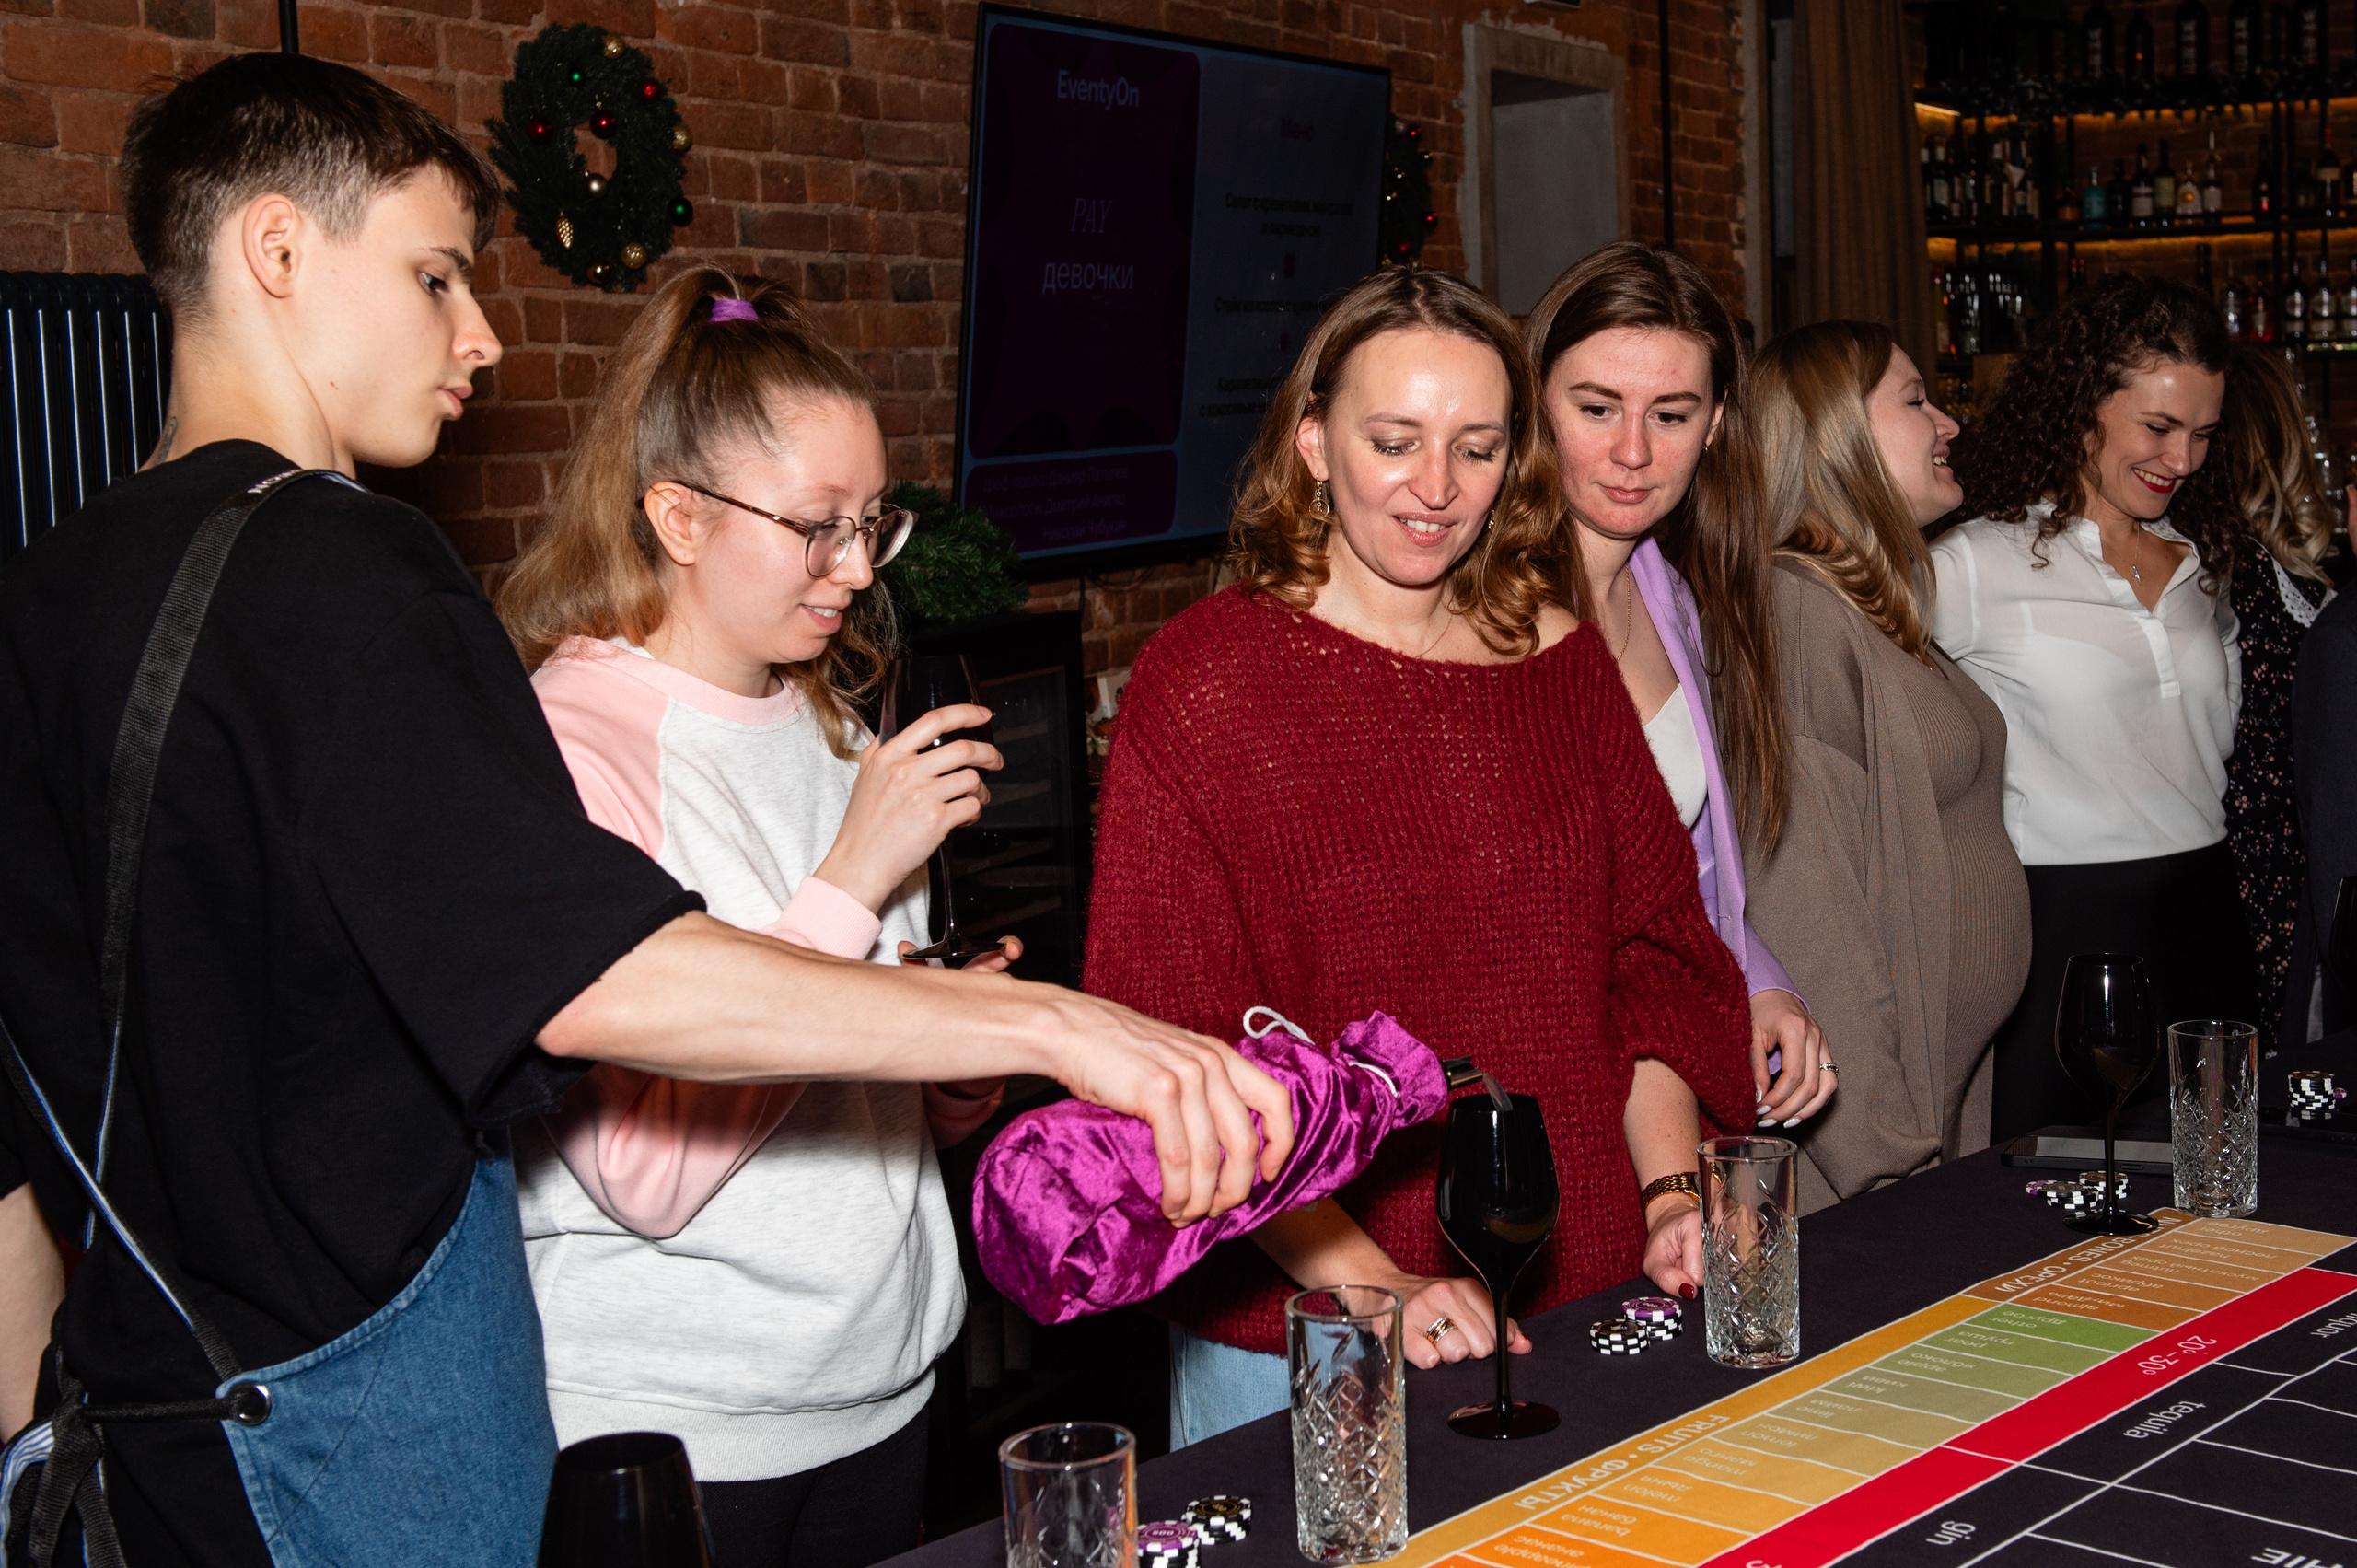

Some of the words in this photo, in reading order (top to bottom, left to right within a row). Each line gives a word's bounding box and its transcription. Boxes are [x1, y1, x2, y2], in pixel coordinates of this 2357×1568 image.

[1057, 68, 1140, 111] EventyOn
[1069, 198, 1113, 234] PAY
[1041, 261, 1134, 296] девочки
[2200, 1226, 2243, 1237] other
[2208, 1221, 2269, 1235] другое
[2159, 1244, 2231, 1260] hazelnut
[2172, 1238, 2211, 1249] орех
[2132, 1255, 2167, 1266] орех
[2213, 1246, 2278, 1260] лесной
[2120, 1259, 2179, 1273] nutmeg
[2170, 1262, 2259, 1281] мускатный
[1994, 1265, 2067, 1293] ОРЕХИ
[2077, 1277, 2140, 1292] apricot
[2091, 1272, 2164, 1289] абрикос
[2032, 1295, 2099, 1310] almond
[2049, 1291, 2126, 1308] миндаль
[1989, 1317, 2038, 1329] other
[2003, 1310, 2067, 1326] другое
[1944, 1337, 1988, 1348] pear
[1958, 1330, 2015, 1345] груша
[1897, 1358, 1947, 1373] apple
[1910, 1353, 1976, 1369] яблоко
[1846, 1381, 1887, 1394] kiwi
[1862, 1375, 1908, 1388] киви
[1796, 1405, 1836, 1419] lime
[1809, 1398, 1862, 1412] лайм
[2122, 1400, 2207, 1439] tequila
[1637, 1414, 1731, 1453] FRUITS
[1740, 1430, 1798, 1449] lemon
[1758, 1423, 1819, 1442] лимон
[1683, 1454, 1747, 1476] mango
[1699, 1446, 1758, 1467] манго
[1513, 1459, 1629, 1510] ФРУКТЫ
[1640, 1475, 1694, 1492] дыня
[1623, 1483, 1681, 1502] melon
[1578, 1504, 1637, 1524] банан
[1561, 1513, 1631, 1537] banana
[1925, 1520, 1977, 1546] gin
[1513, 1535, 1585, 1558] ананас
